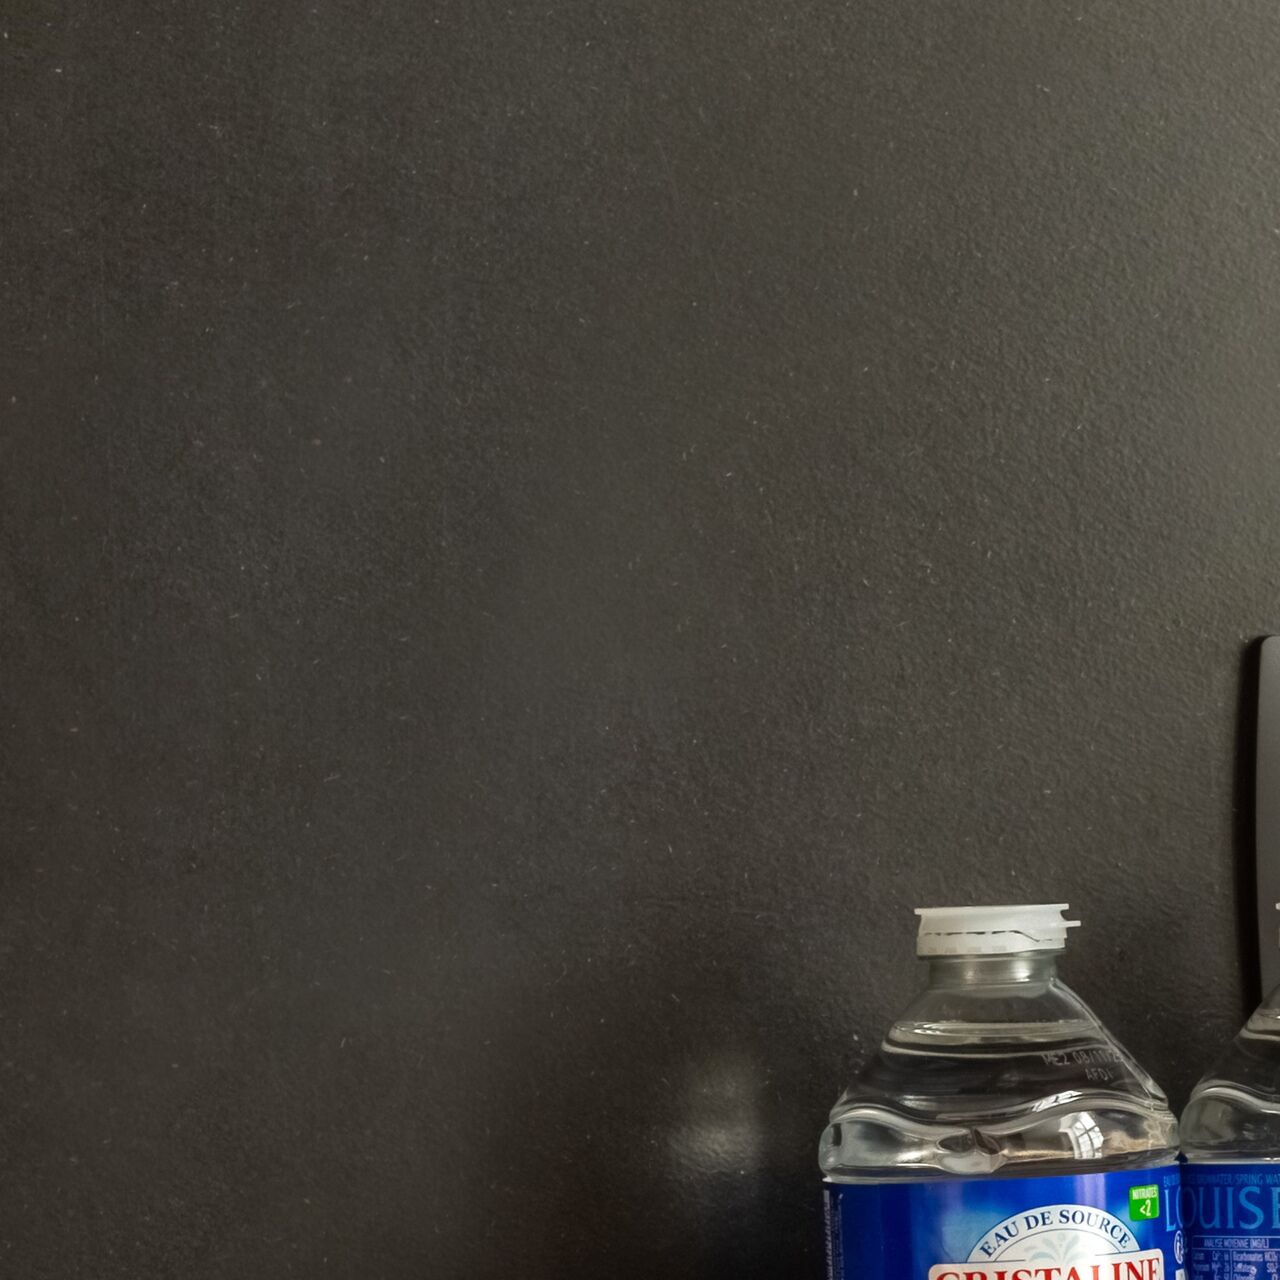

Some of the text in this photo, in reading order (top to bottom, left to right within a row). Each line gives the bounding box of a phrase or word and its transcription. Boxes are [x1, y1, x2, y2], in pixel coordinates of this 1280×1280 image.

[1139, 1199, 1152, 1217] <2
[979, 1221, 1020, 1258] EAU
[1023, 1210, 1054, 1231] DE
[1058, 1208, 1131, 1249] SOURCE
